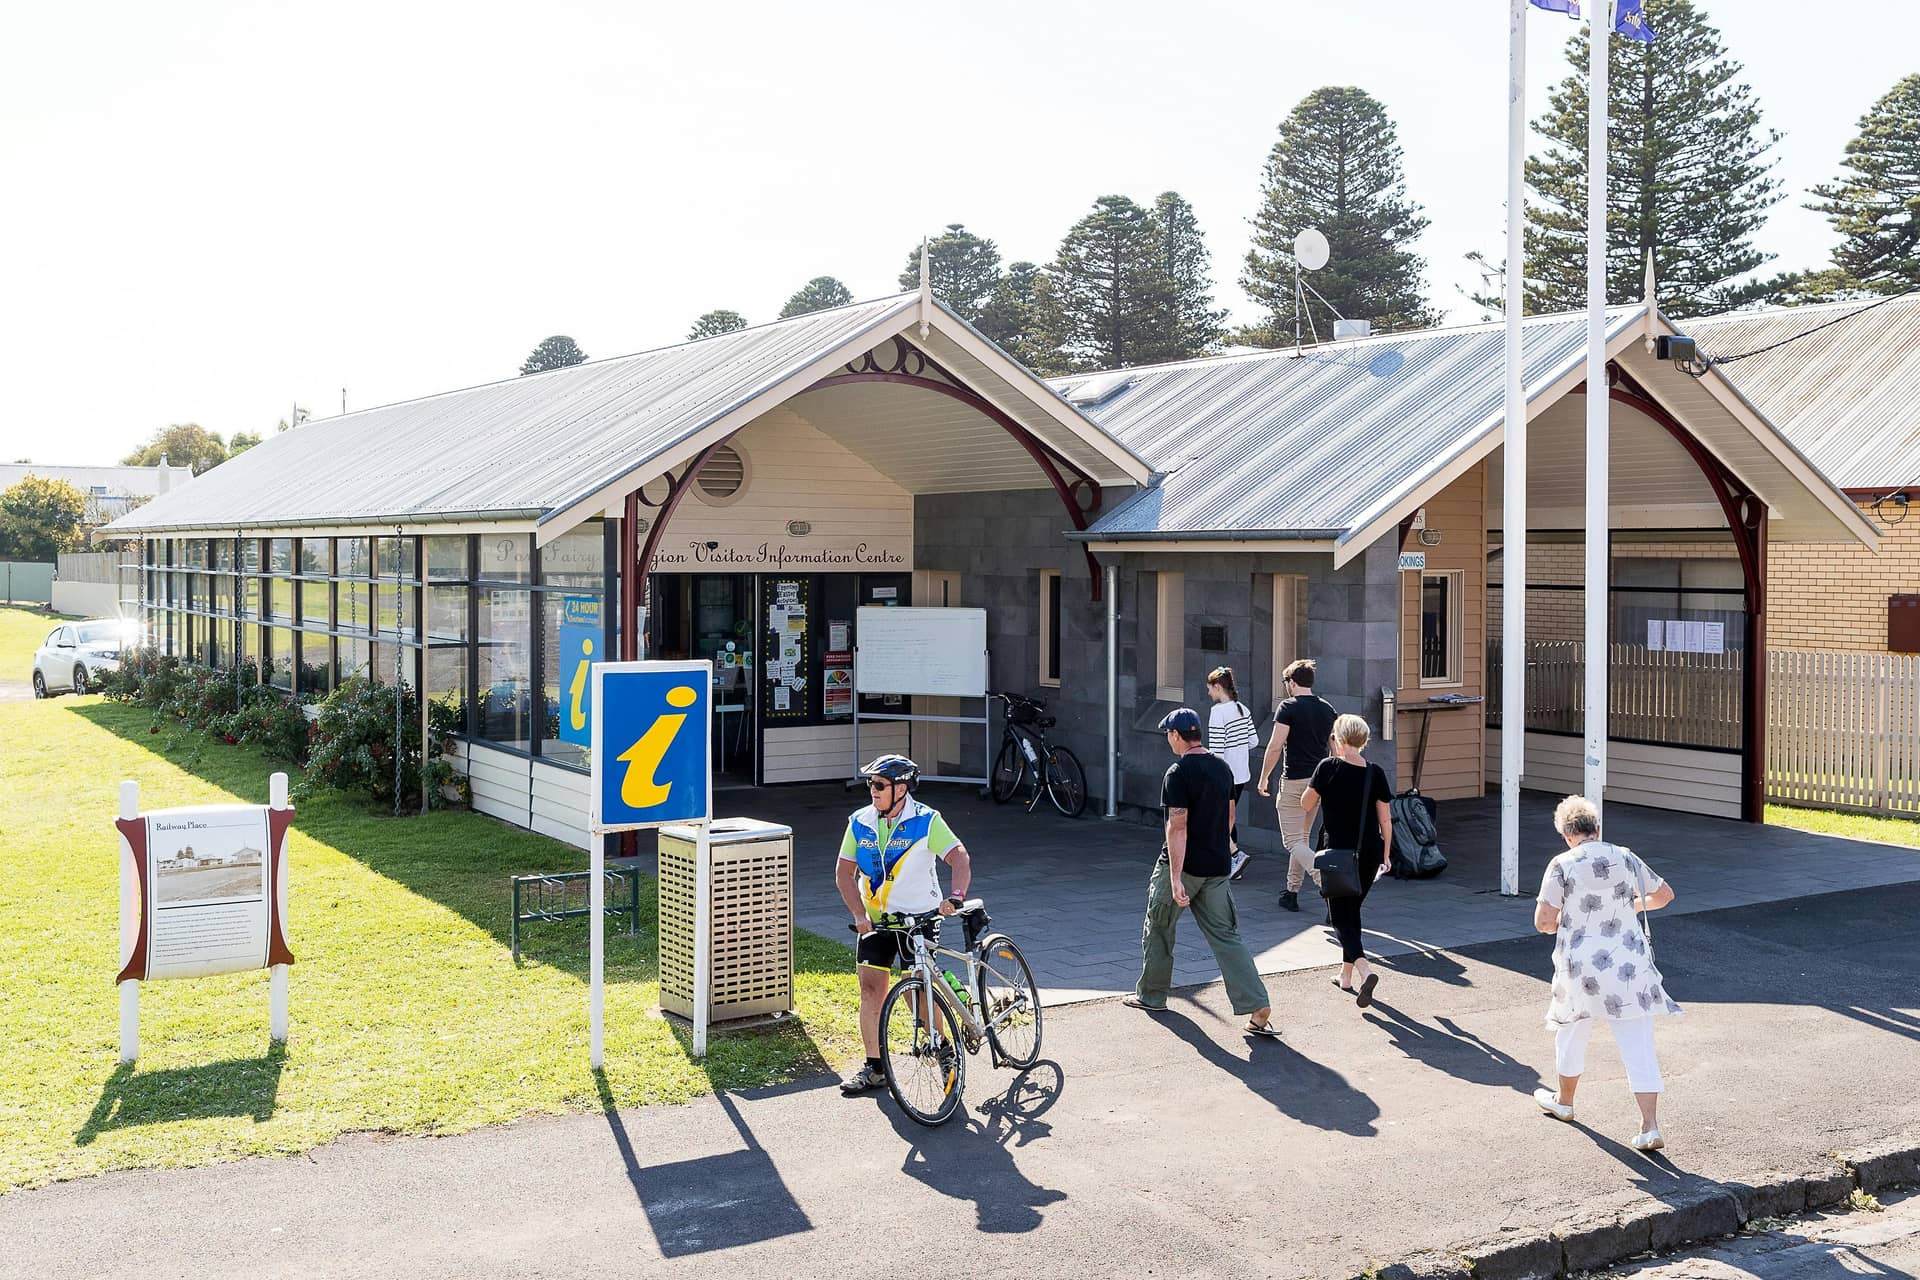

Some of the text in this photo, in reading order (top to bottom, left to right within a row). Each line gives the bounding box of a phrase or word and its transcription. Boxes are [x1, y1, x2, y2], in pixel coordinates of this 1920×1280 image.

[496, 539, 530, 562] Po
[650, 541, 904, 571] gion Visitor Information Centre
[1399, 555, 1424, 567] OKINGS
[580, 601, 598, 614] HOUR
[616, 686, 697, 808] i
[156, 821, 208, 831] Railway Place
